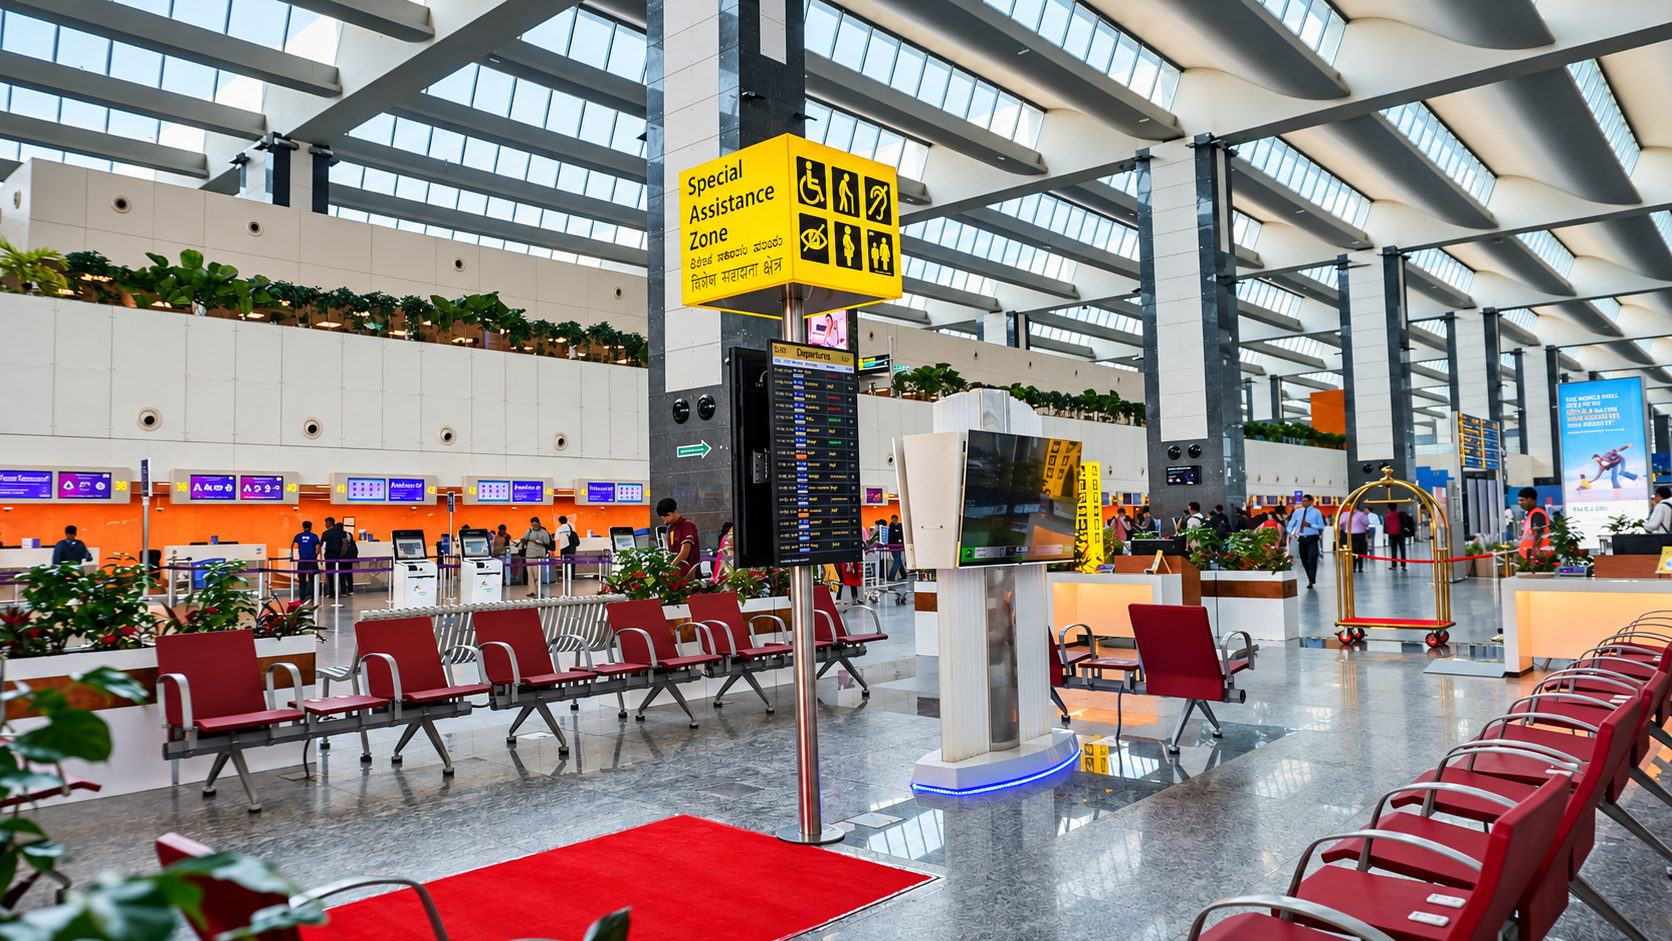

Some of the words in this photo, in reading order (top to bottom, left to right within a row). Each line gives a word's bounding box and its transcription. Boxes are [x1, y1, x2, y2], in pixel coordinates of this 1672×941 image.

[688, 159, 743, 197] Special
[689, 185, 775, 225] Assistance
[689, 227, 728, 251] Zone
